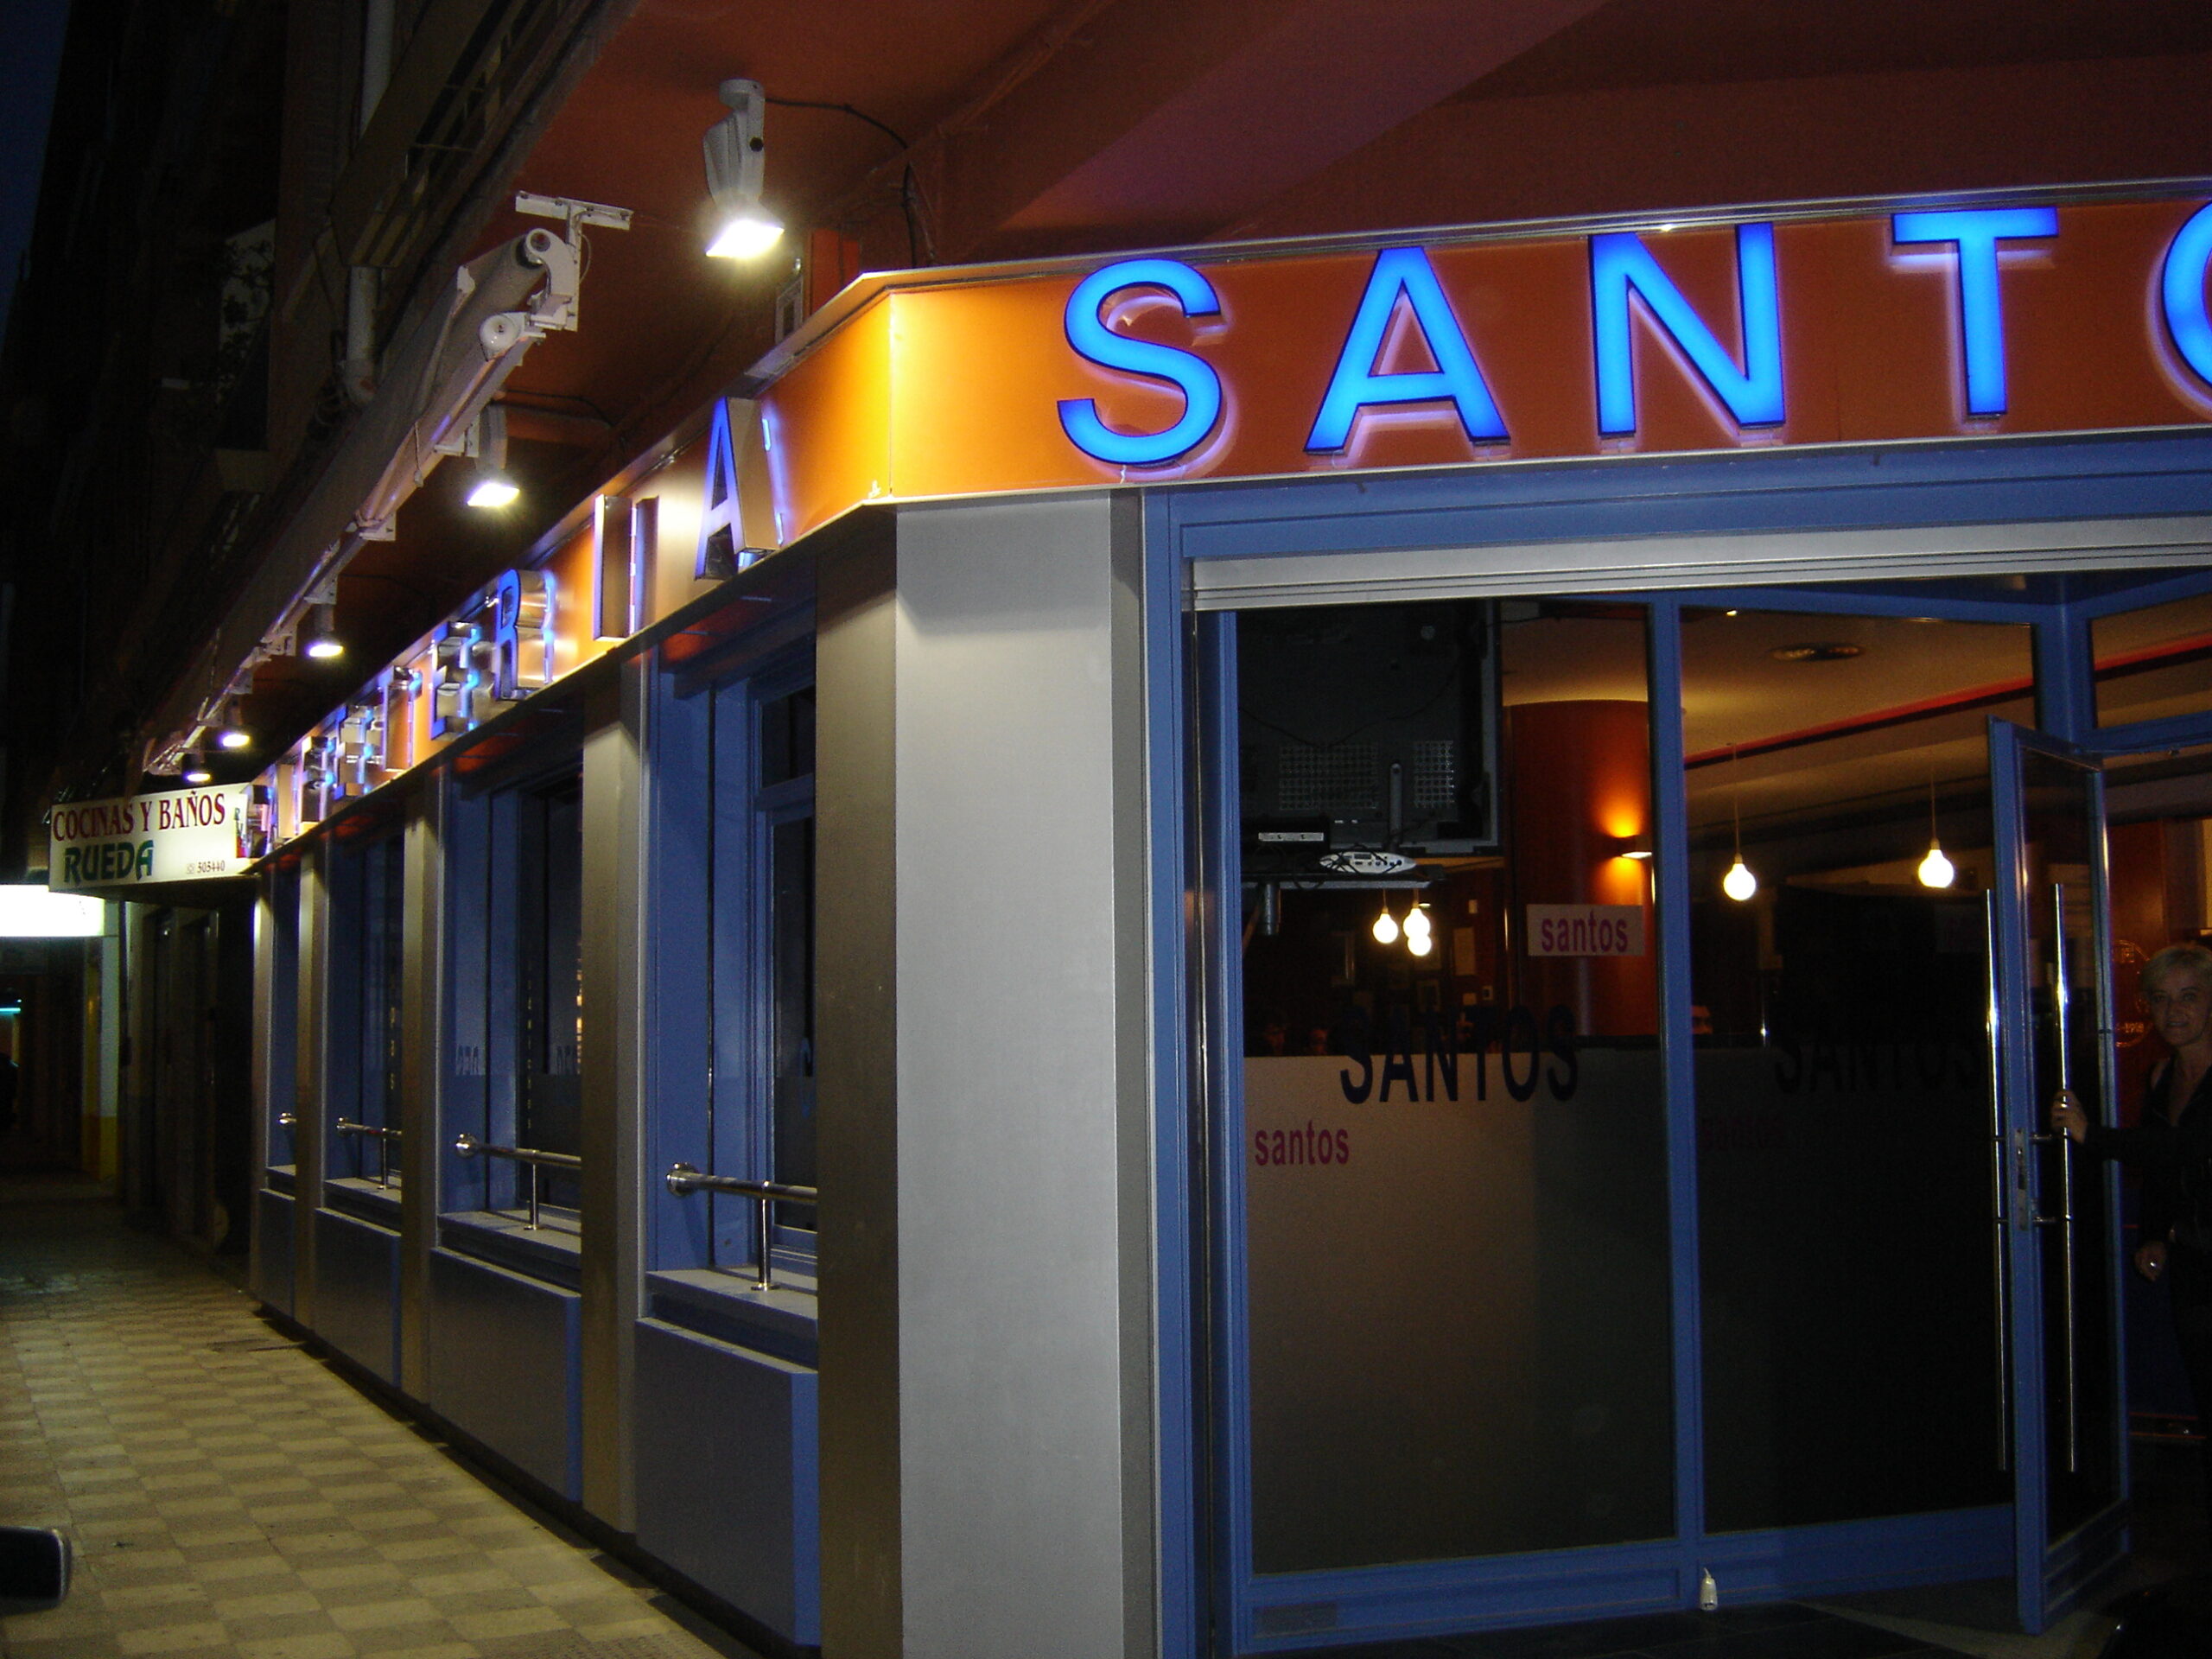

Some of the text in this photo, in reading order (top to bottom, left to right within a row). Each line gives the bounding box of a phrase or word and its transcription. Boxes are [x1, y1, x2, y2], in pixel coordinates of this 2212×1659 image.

[1056, 202, 2212, 467] SANT
[52, 804, 134, 842] COCINAS
[140, 800, 153, 832] Y
[159, 791, 226, 830] BAÑOS
[64, 840, 155, 887] RUEDA
[1541, 911, 1629, 952] santos
[1340, 1005, 1579, 1104] SANTOS
[1255, 1121, 1350, 1166] santos
